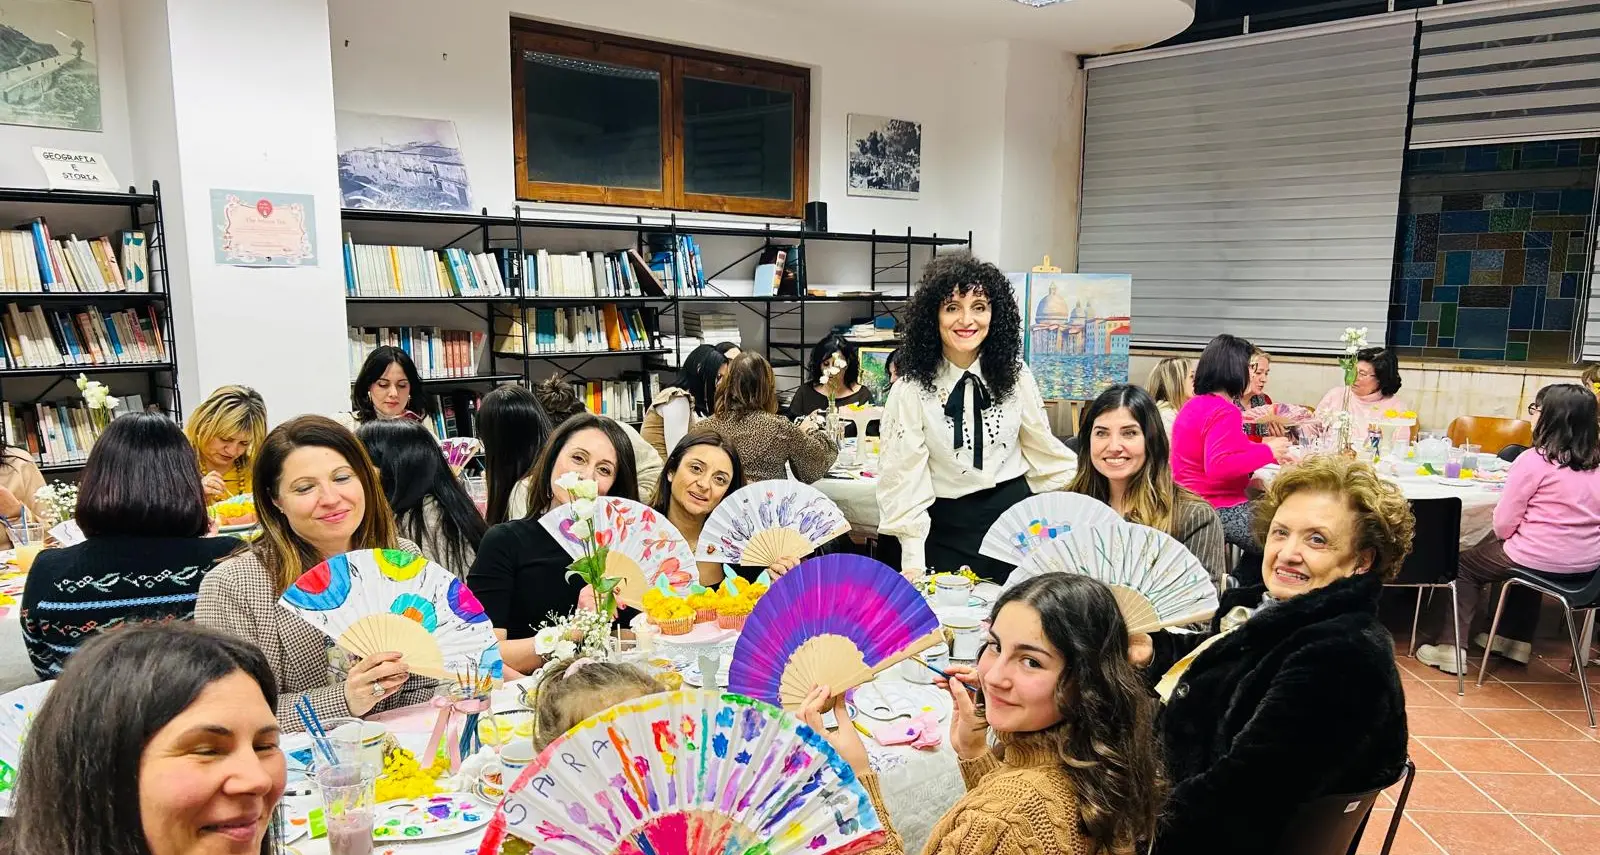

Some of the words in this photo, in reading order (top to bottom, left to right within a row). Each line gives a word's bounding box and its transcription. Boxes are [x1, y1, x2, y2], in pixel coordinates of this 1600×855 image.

[42, 151, 96, 163] GEOGRAFIA
[70, 163, 79, 172] E
[62, 172, 99, 181] STORIA
[503, 740, 609, 826] SARA
